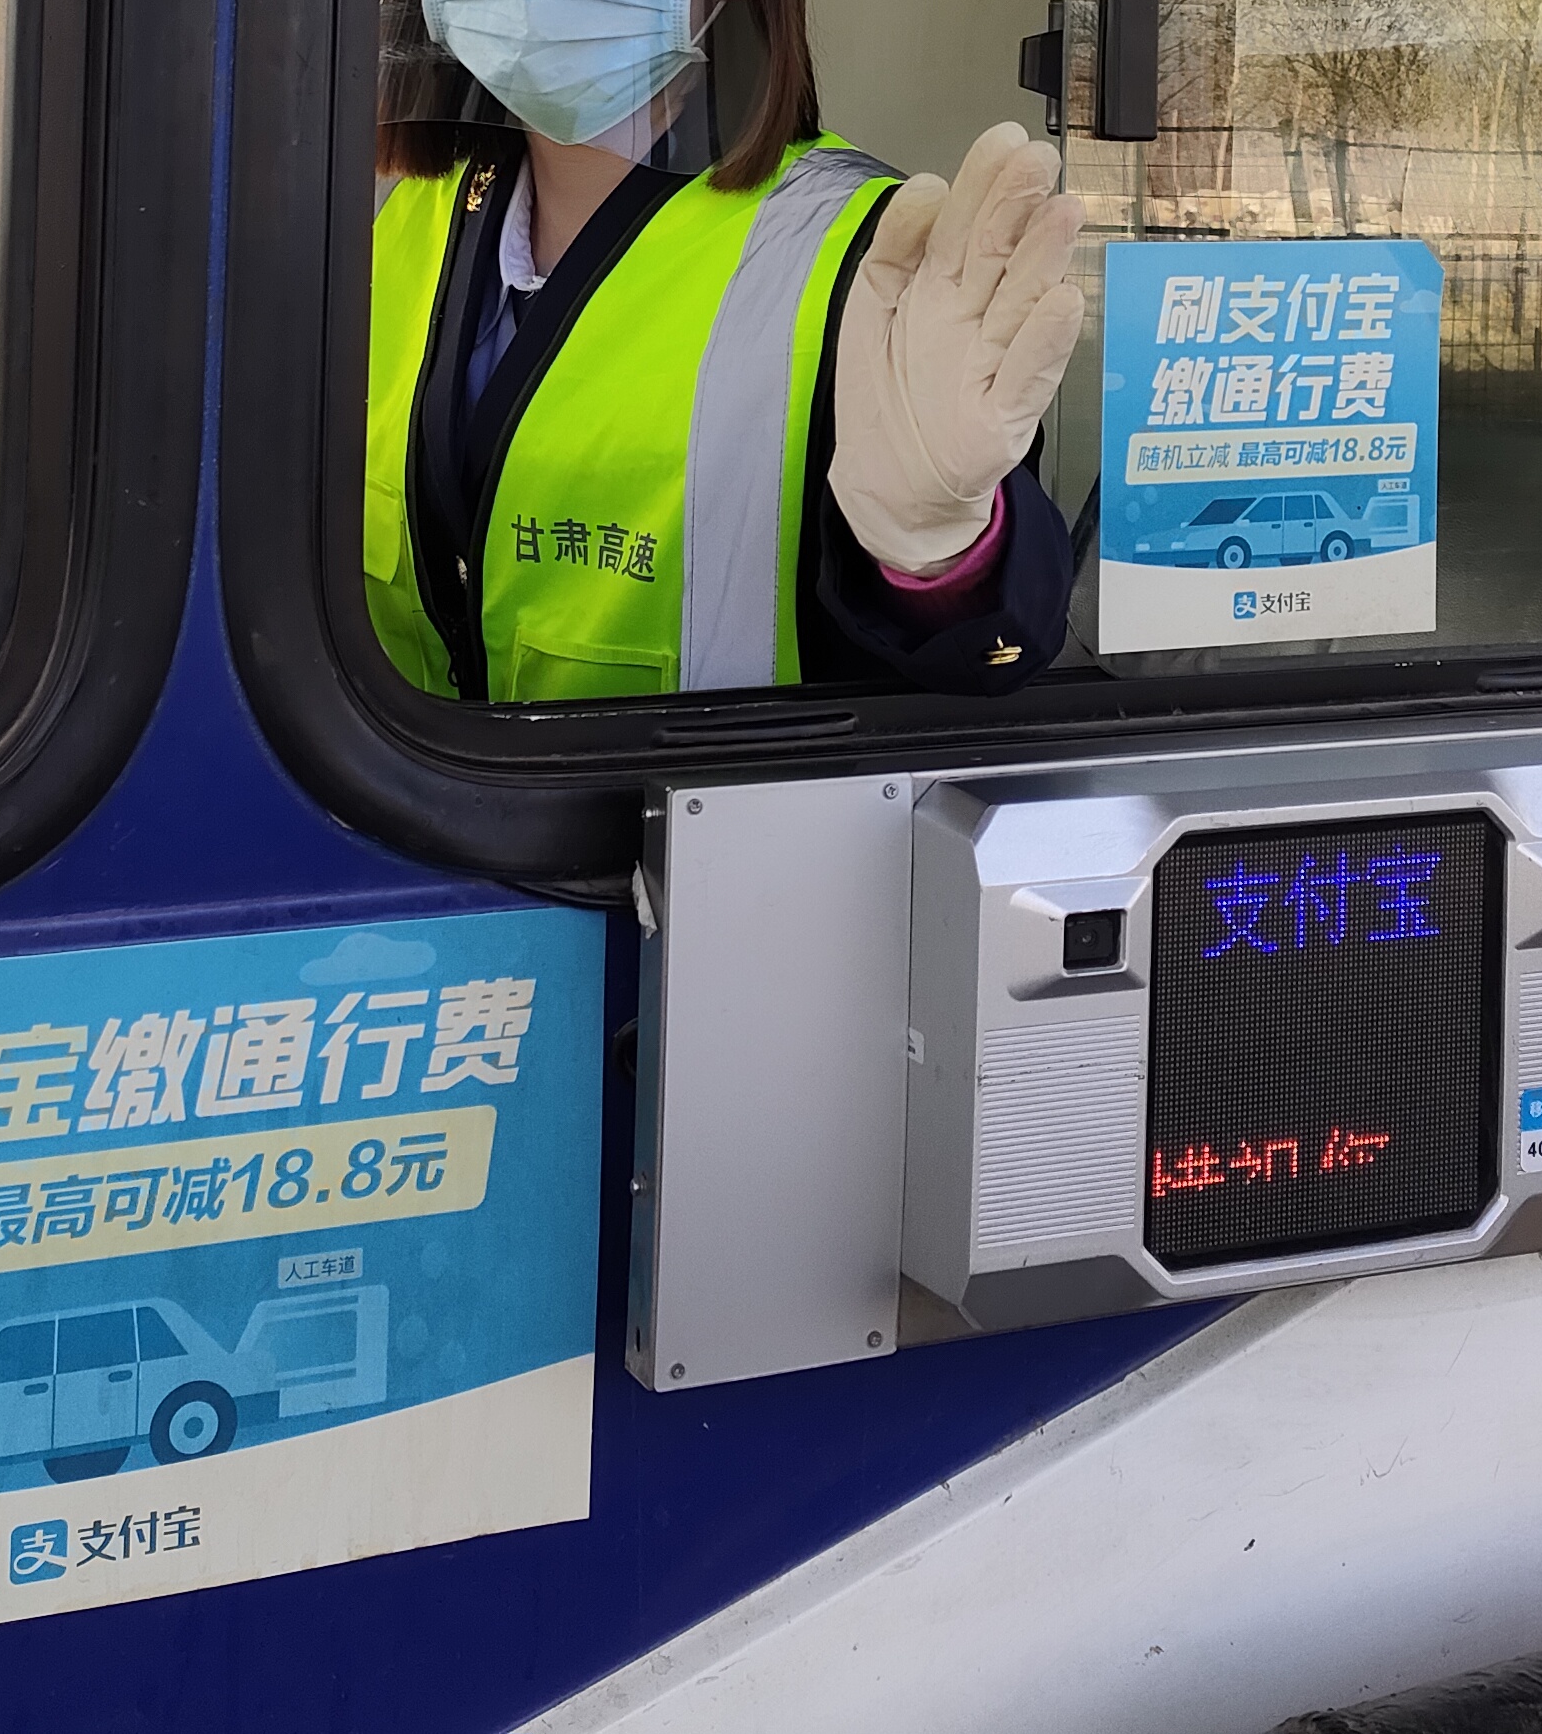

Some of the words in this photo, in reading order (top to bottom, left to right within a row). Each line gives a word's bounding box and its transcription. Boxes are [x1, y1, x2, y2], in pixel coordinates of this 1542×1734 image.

[1156, 273, 1400, 345] 刷支付宝
[1146, 352, 1395, 426] 缴通行费
[1136, 443, 1231, 472] 随机立减
[1235, 436, 1408, 468] 最高可减18.8元
[510, 515, 658, 583] 甘肃高速
[1260, 591, 1312, 614] 支付宝
[1202, 844, 1444, 958] 支付宝
[284, 1254, 356, 1282] 人工车道
[75, 1505, 202, 1568] 支付宝
